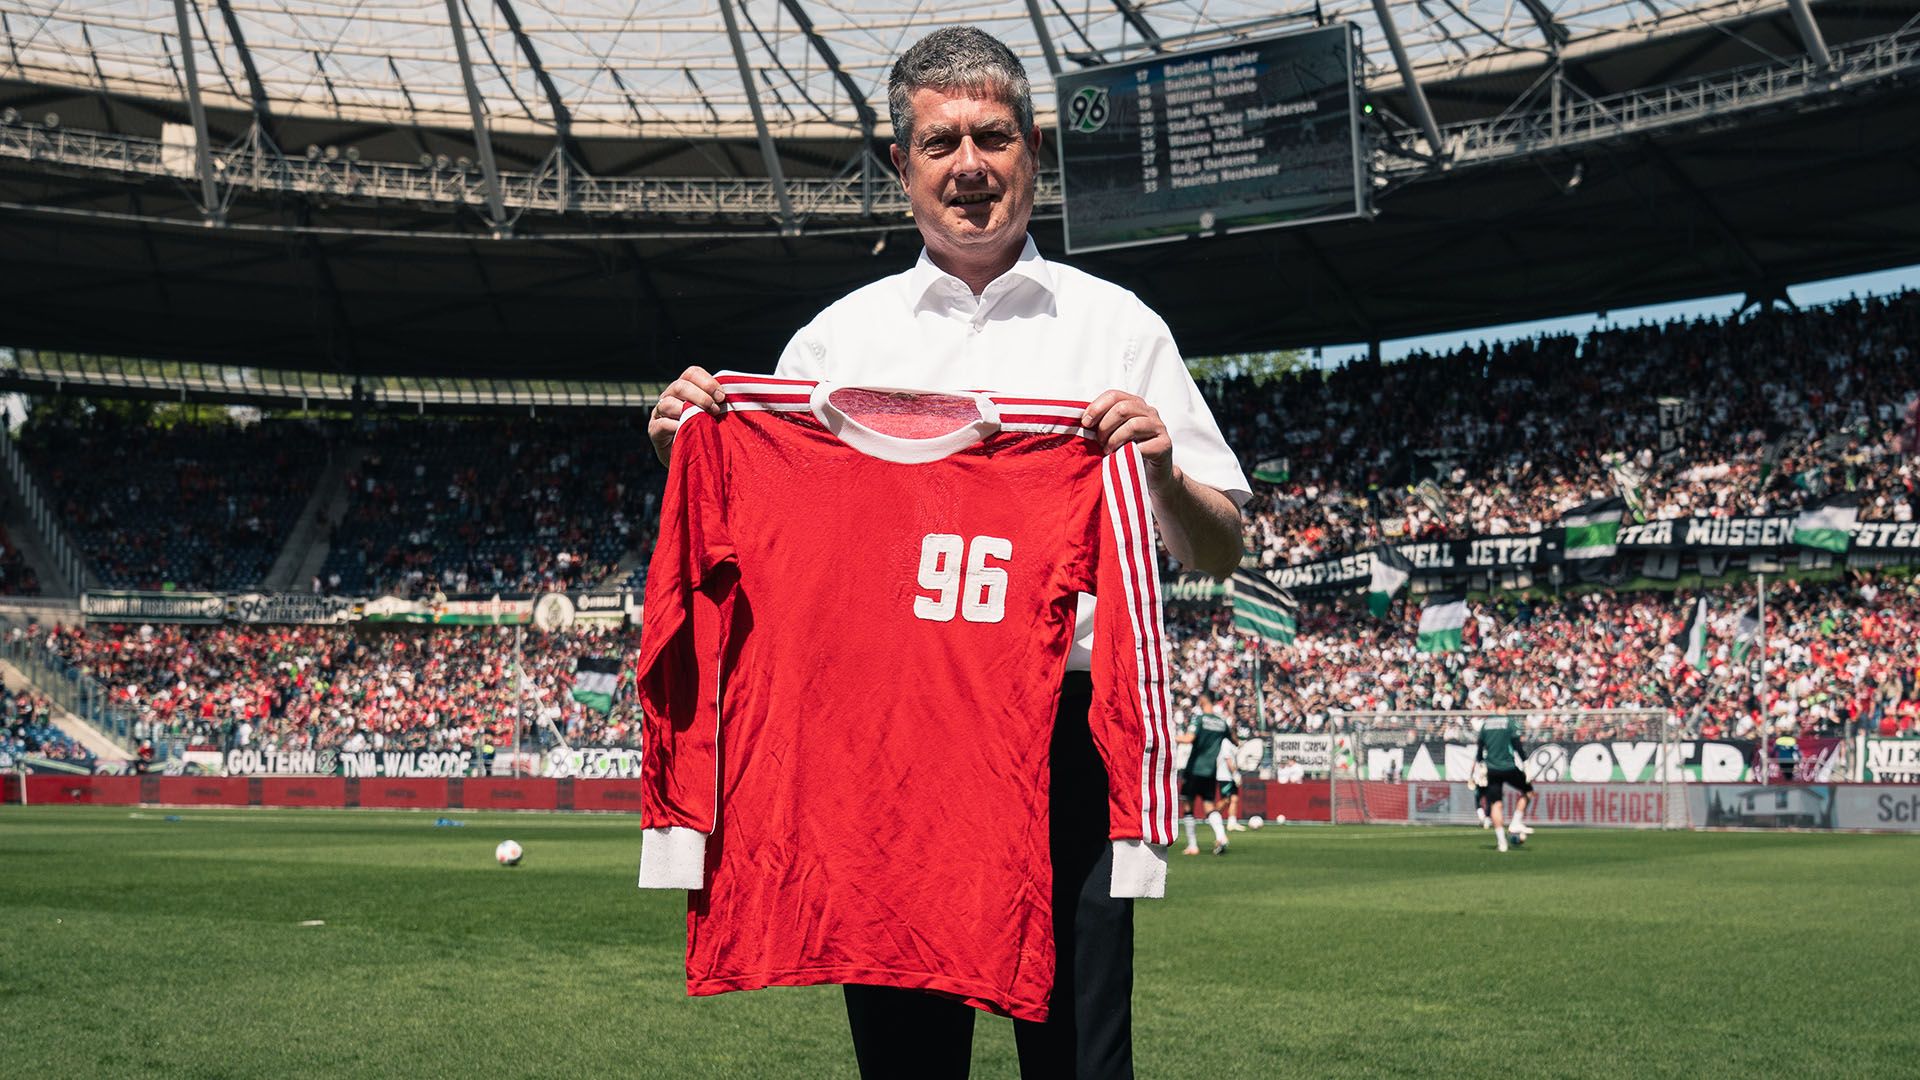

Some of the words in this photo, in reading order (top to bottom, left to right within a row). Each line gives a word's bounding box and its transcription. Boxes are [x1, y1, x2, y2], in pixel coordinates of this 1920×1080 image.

[1466, 537, 1542, 565] JETZT
[913, 533, 1013, 623] 96
[228, 749, 316, 775] GOLTERN
[1545, 791, 1586, 822] VON
